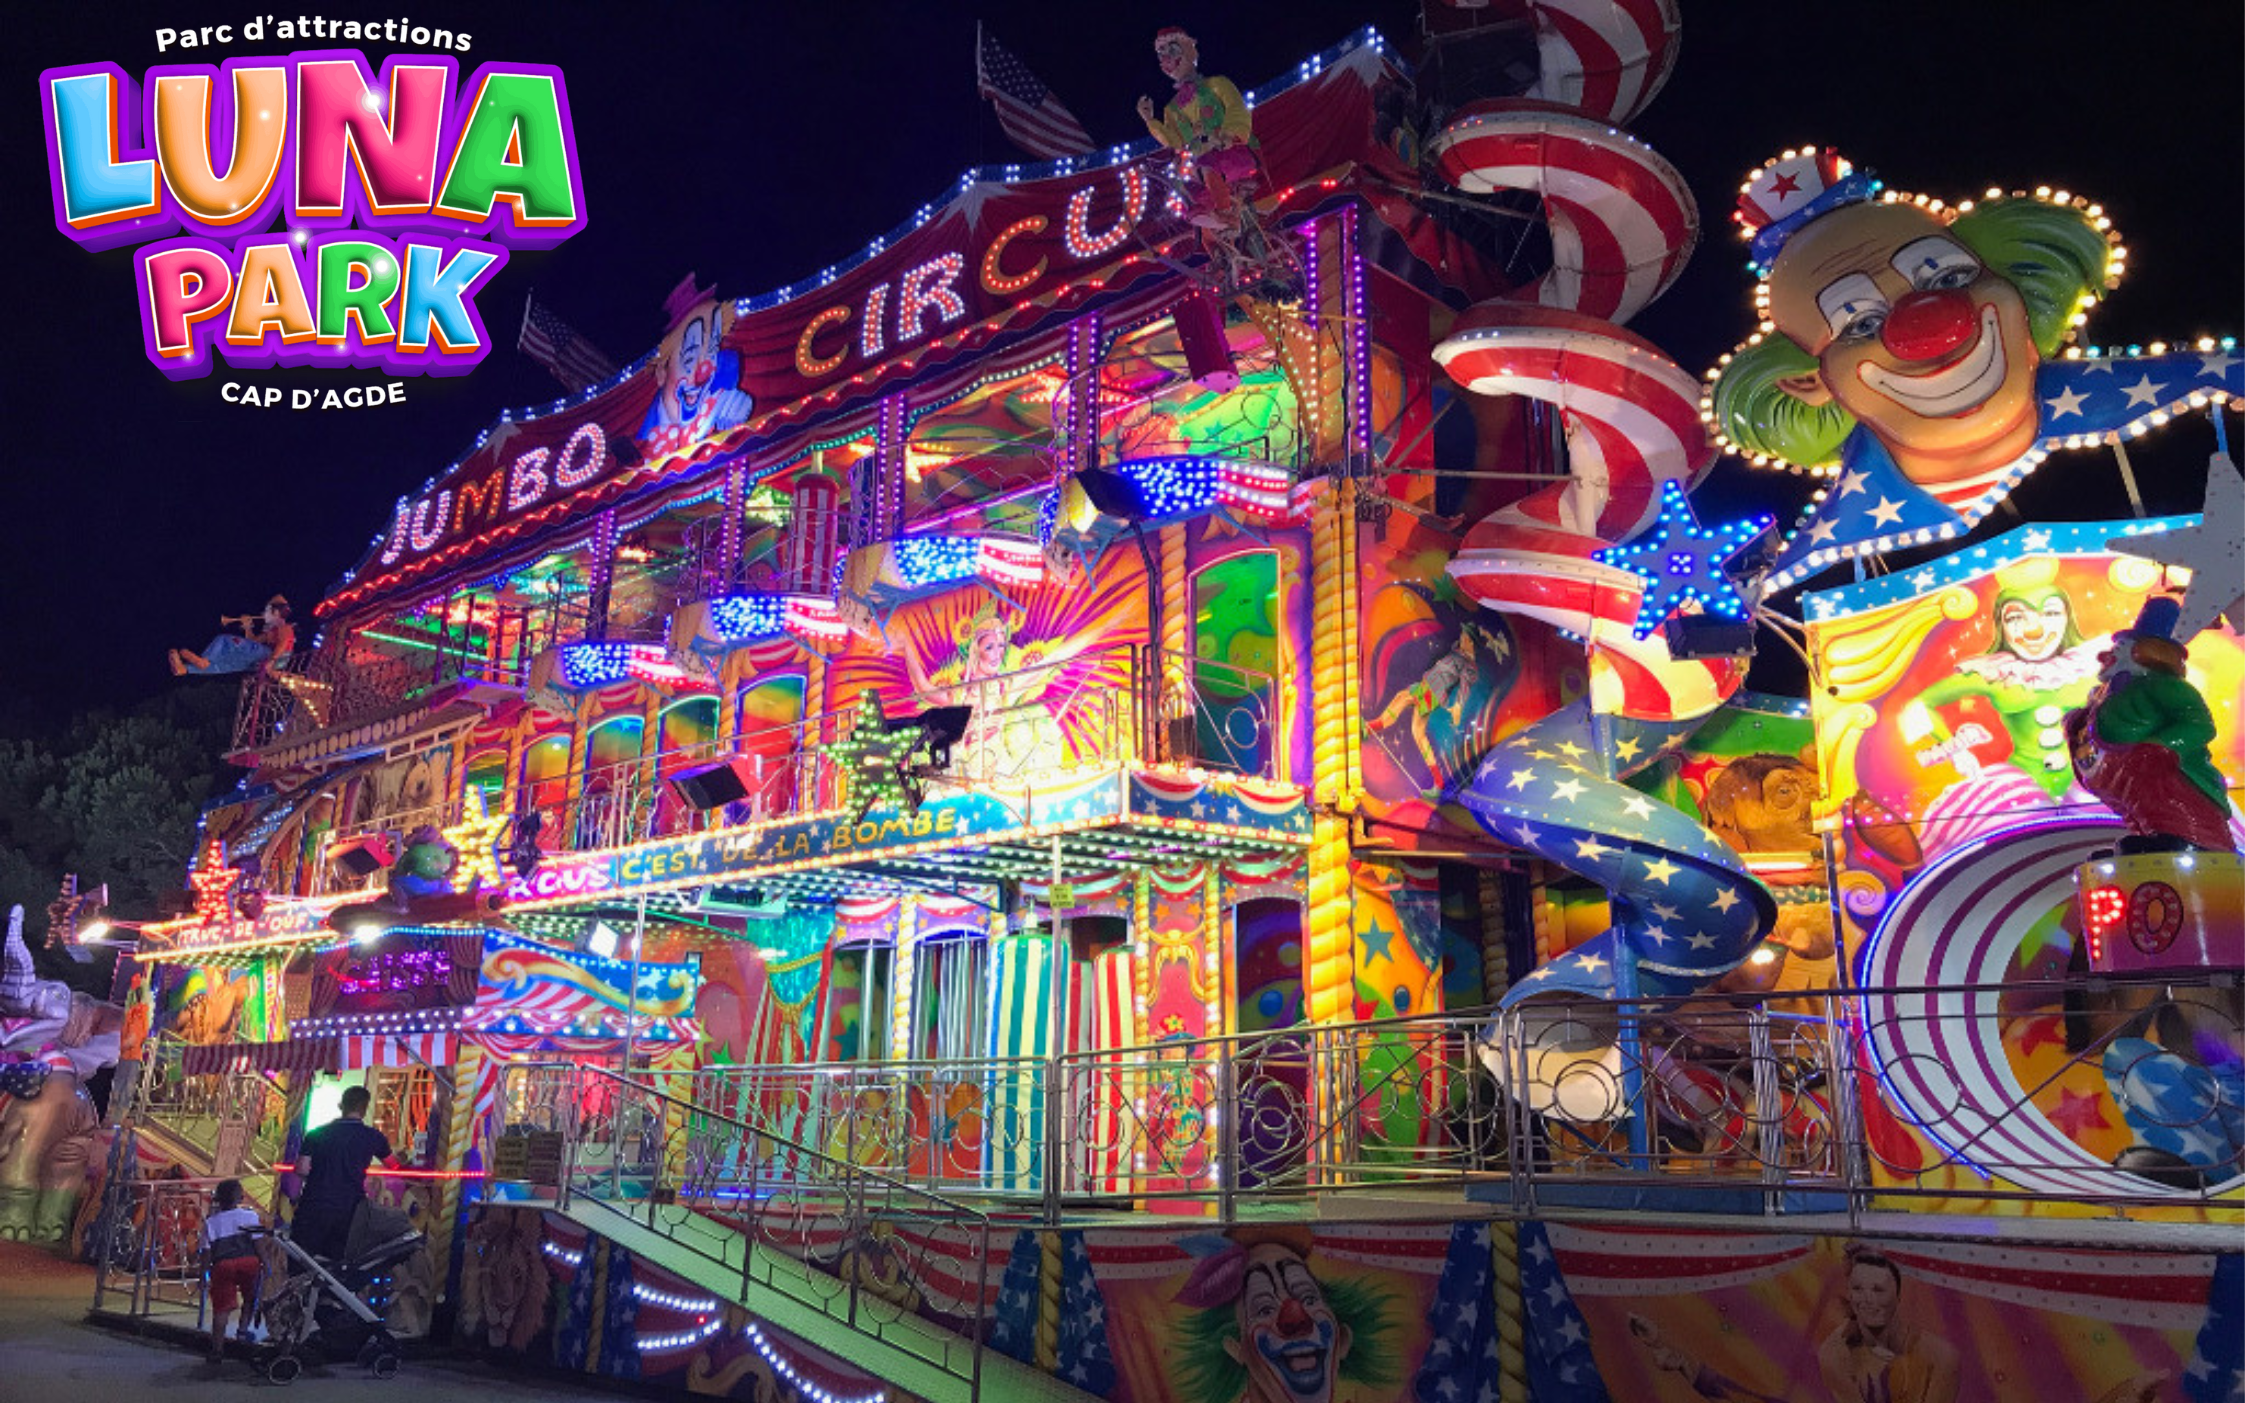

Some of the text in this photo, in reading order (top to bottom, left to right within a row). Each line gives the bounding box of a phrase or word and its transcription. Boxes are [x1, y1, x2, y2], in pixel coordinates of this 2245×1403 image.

[381, 422, 607, 566] JUMBO
[721, 840, 758, 863] DE
[776, 831, 811, 858] LA
[831, 807, 957, 849] BOMBE
[2088, 880, 2184, 961] PO
